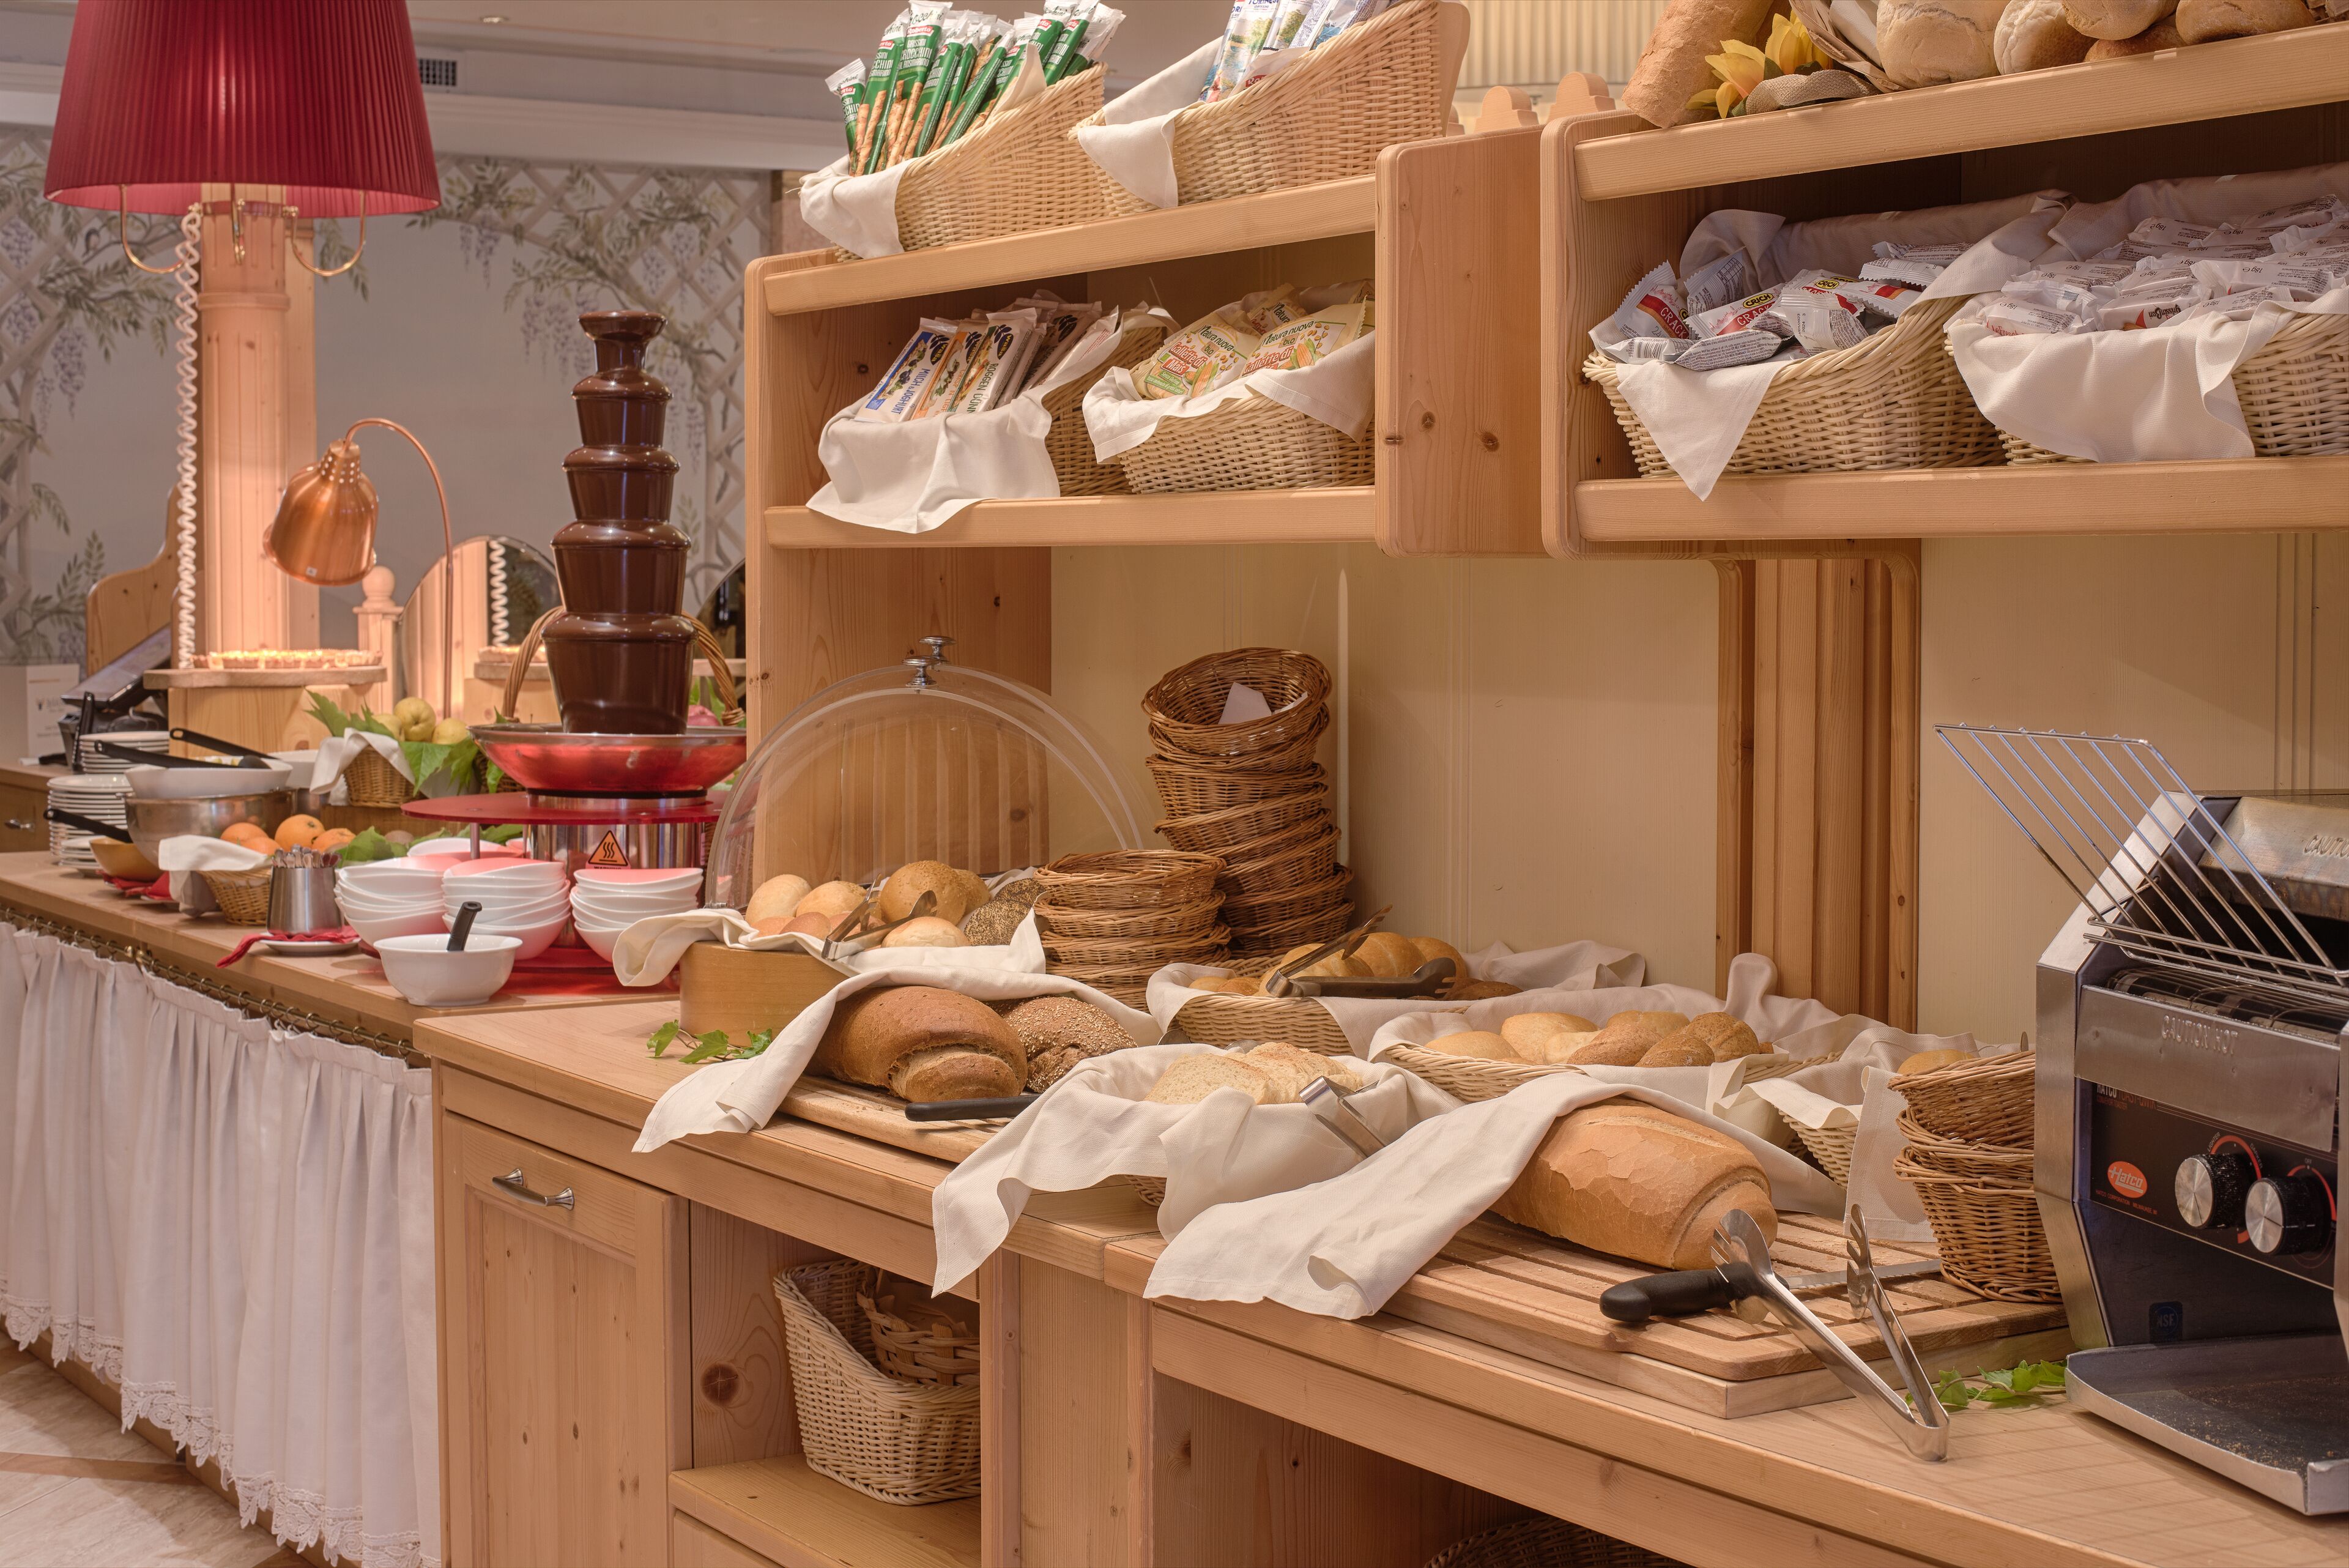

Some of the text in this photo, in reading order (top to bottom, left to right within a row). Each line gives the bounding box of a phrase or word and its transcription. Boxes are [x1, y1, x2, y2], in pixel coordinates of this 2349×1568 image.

[907, 26, 932, 35] Roberto
[907, 39, 927, 48] GRISSINI
[901, 48, 932, 60] CROCCHINI
[904, 58, 930, 69] ROSMARINO
[2155, 222, 2167, 231] 18g
[1817, 280, 1839, 289] CRICH
[1745, 294, 1771, 307] CRICH
[1198, 325, 1234, 351] Natura nuova
[1263, 321, 1314, 347] Natura nuova
[1283, 337, 1296, 346] bio
[1170, 341, 1209, 368] Gallette di
[1203, 344, 1215, 355] bio
[1280, 346, 1294, 360] di
[1166, 359, 1187, 374] Mais
[913, 368, 930, 386] MILCH
[976, 363, 1000, 391] ROGGEN
[891, 388, 916, 415] JOGHURT
[2162, 1015, 2239, 1055] CAUTION HOT
[2206, 1132, 2263, 1169] LIGHTER DARKER
[2109, 1166, 2144, 1194] Hatco
